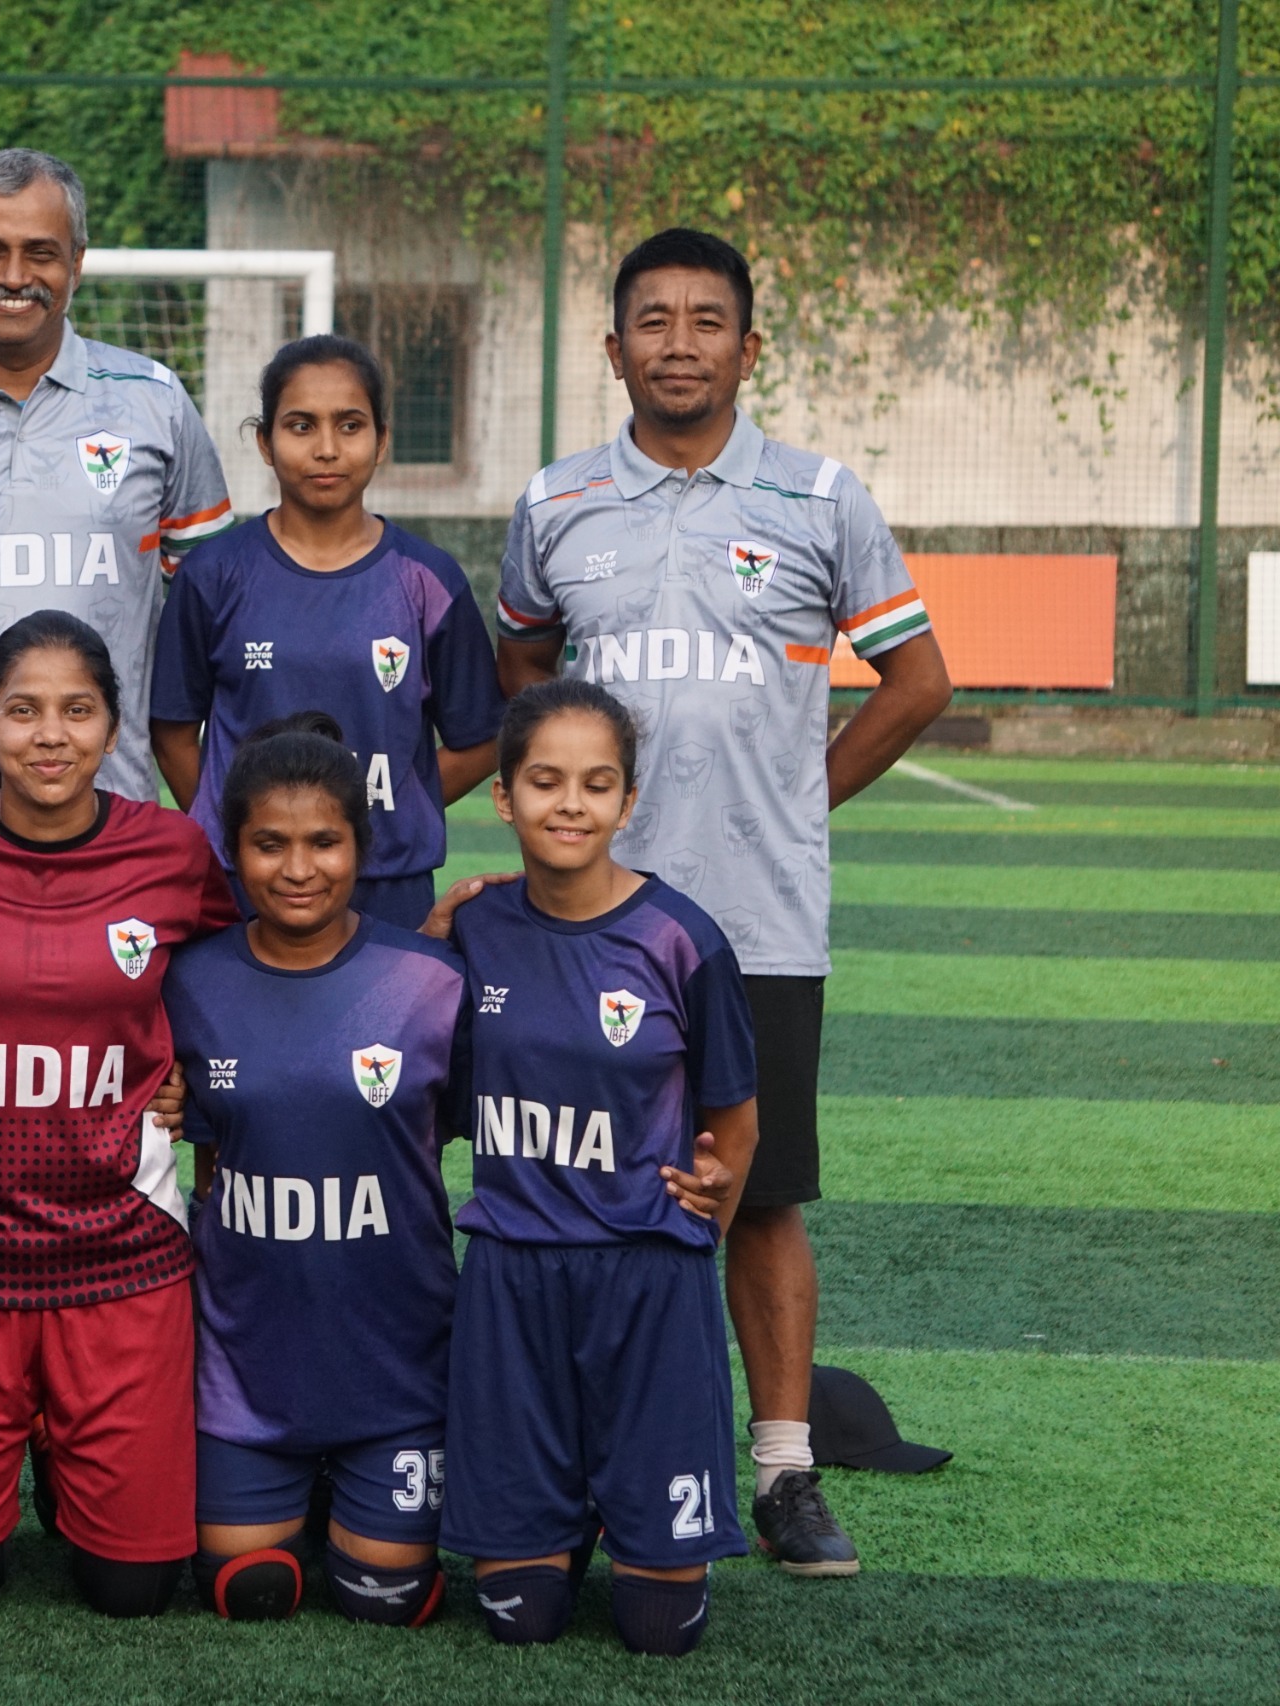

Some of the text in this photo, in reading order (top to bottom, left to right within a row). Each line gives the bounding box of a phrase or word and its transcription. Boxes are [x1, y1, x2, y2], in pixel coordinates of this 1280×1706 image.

[96, 473, 119, 489] IBFF
[584, 560, 617, 574] VECTOR
[742, 575, 765, 593] IBFF
[583, 628, 766, 686] INDIA
[382, 673, 398, 688] IBFF
[125, 959, 144, 975] IBFF
[609, 1026, 630, 1043] IBFF
[209, 1070, 236, 1078] VECTOR
[368, 1087, 389, 1103] IBFF
[475, 1095, 615, 1173] INDIA
[221, 1166, 390, 1242] INDIA
[392, 1450, 445, 1511] 35
[668, 1468, 715, 1539] 21
